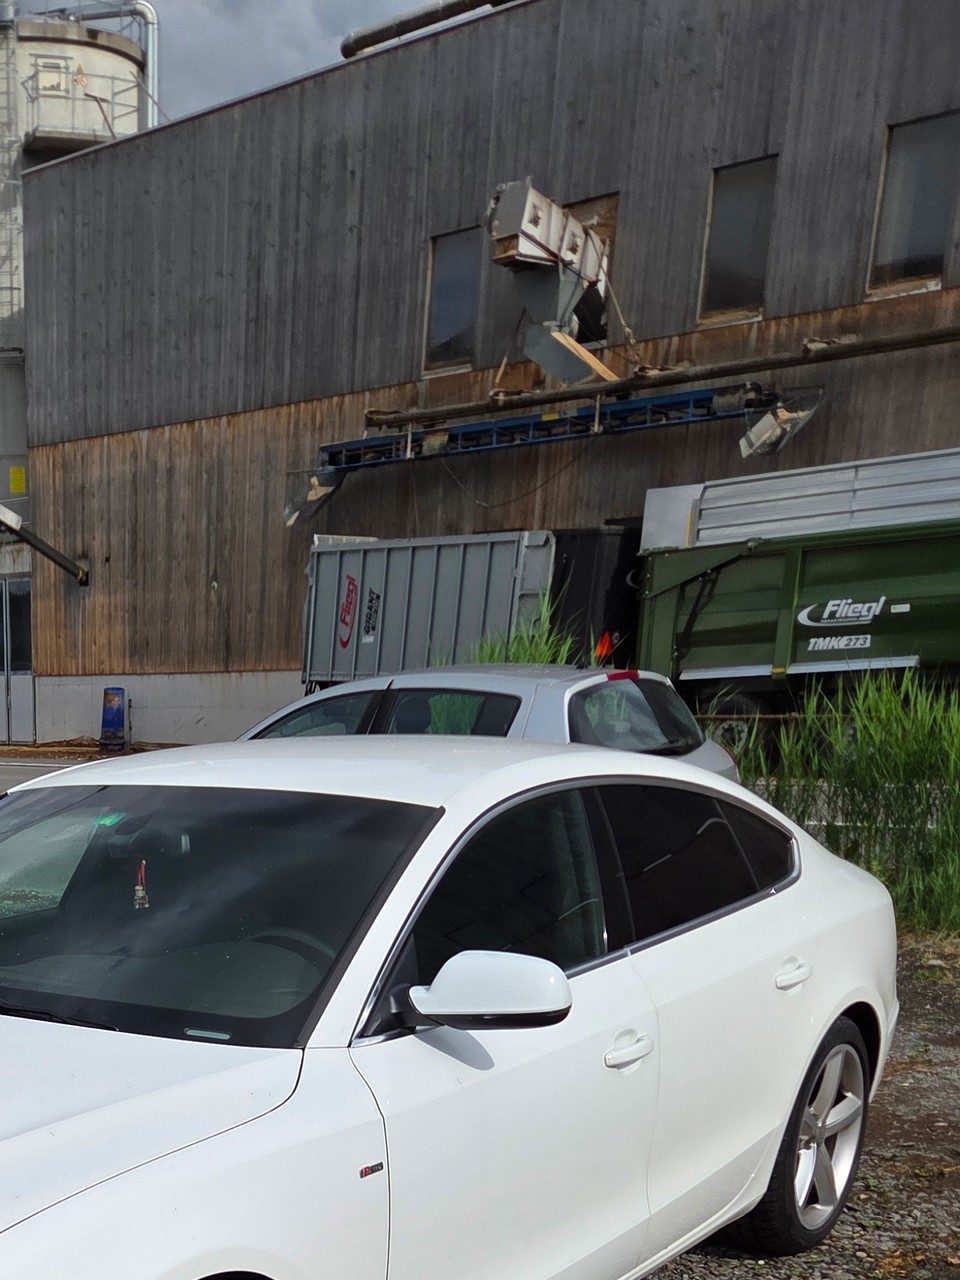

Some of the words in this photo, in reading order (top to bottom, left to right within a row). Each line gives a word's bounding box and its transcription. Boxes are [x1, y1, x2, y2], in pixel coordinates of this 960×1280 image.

[340, 574, 357, 627] Fliegl
[822, 596, 887, 621] Fliegl
[807, 636, 842, 651] TMK
[844, 635, 870, 649] 273
